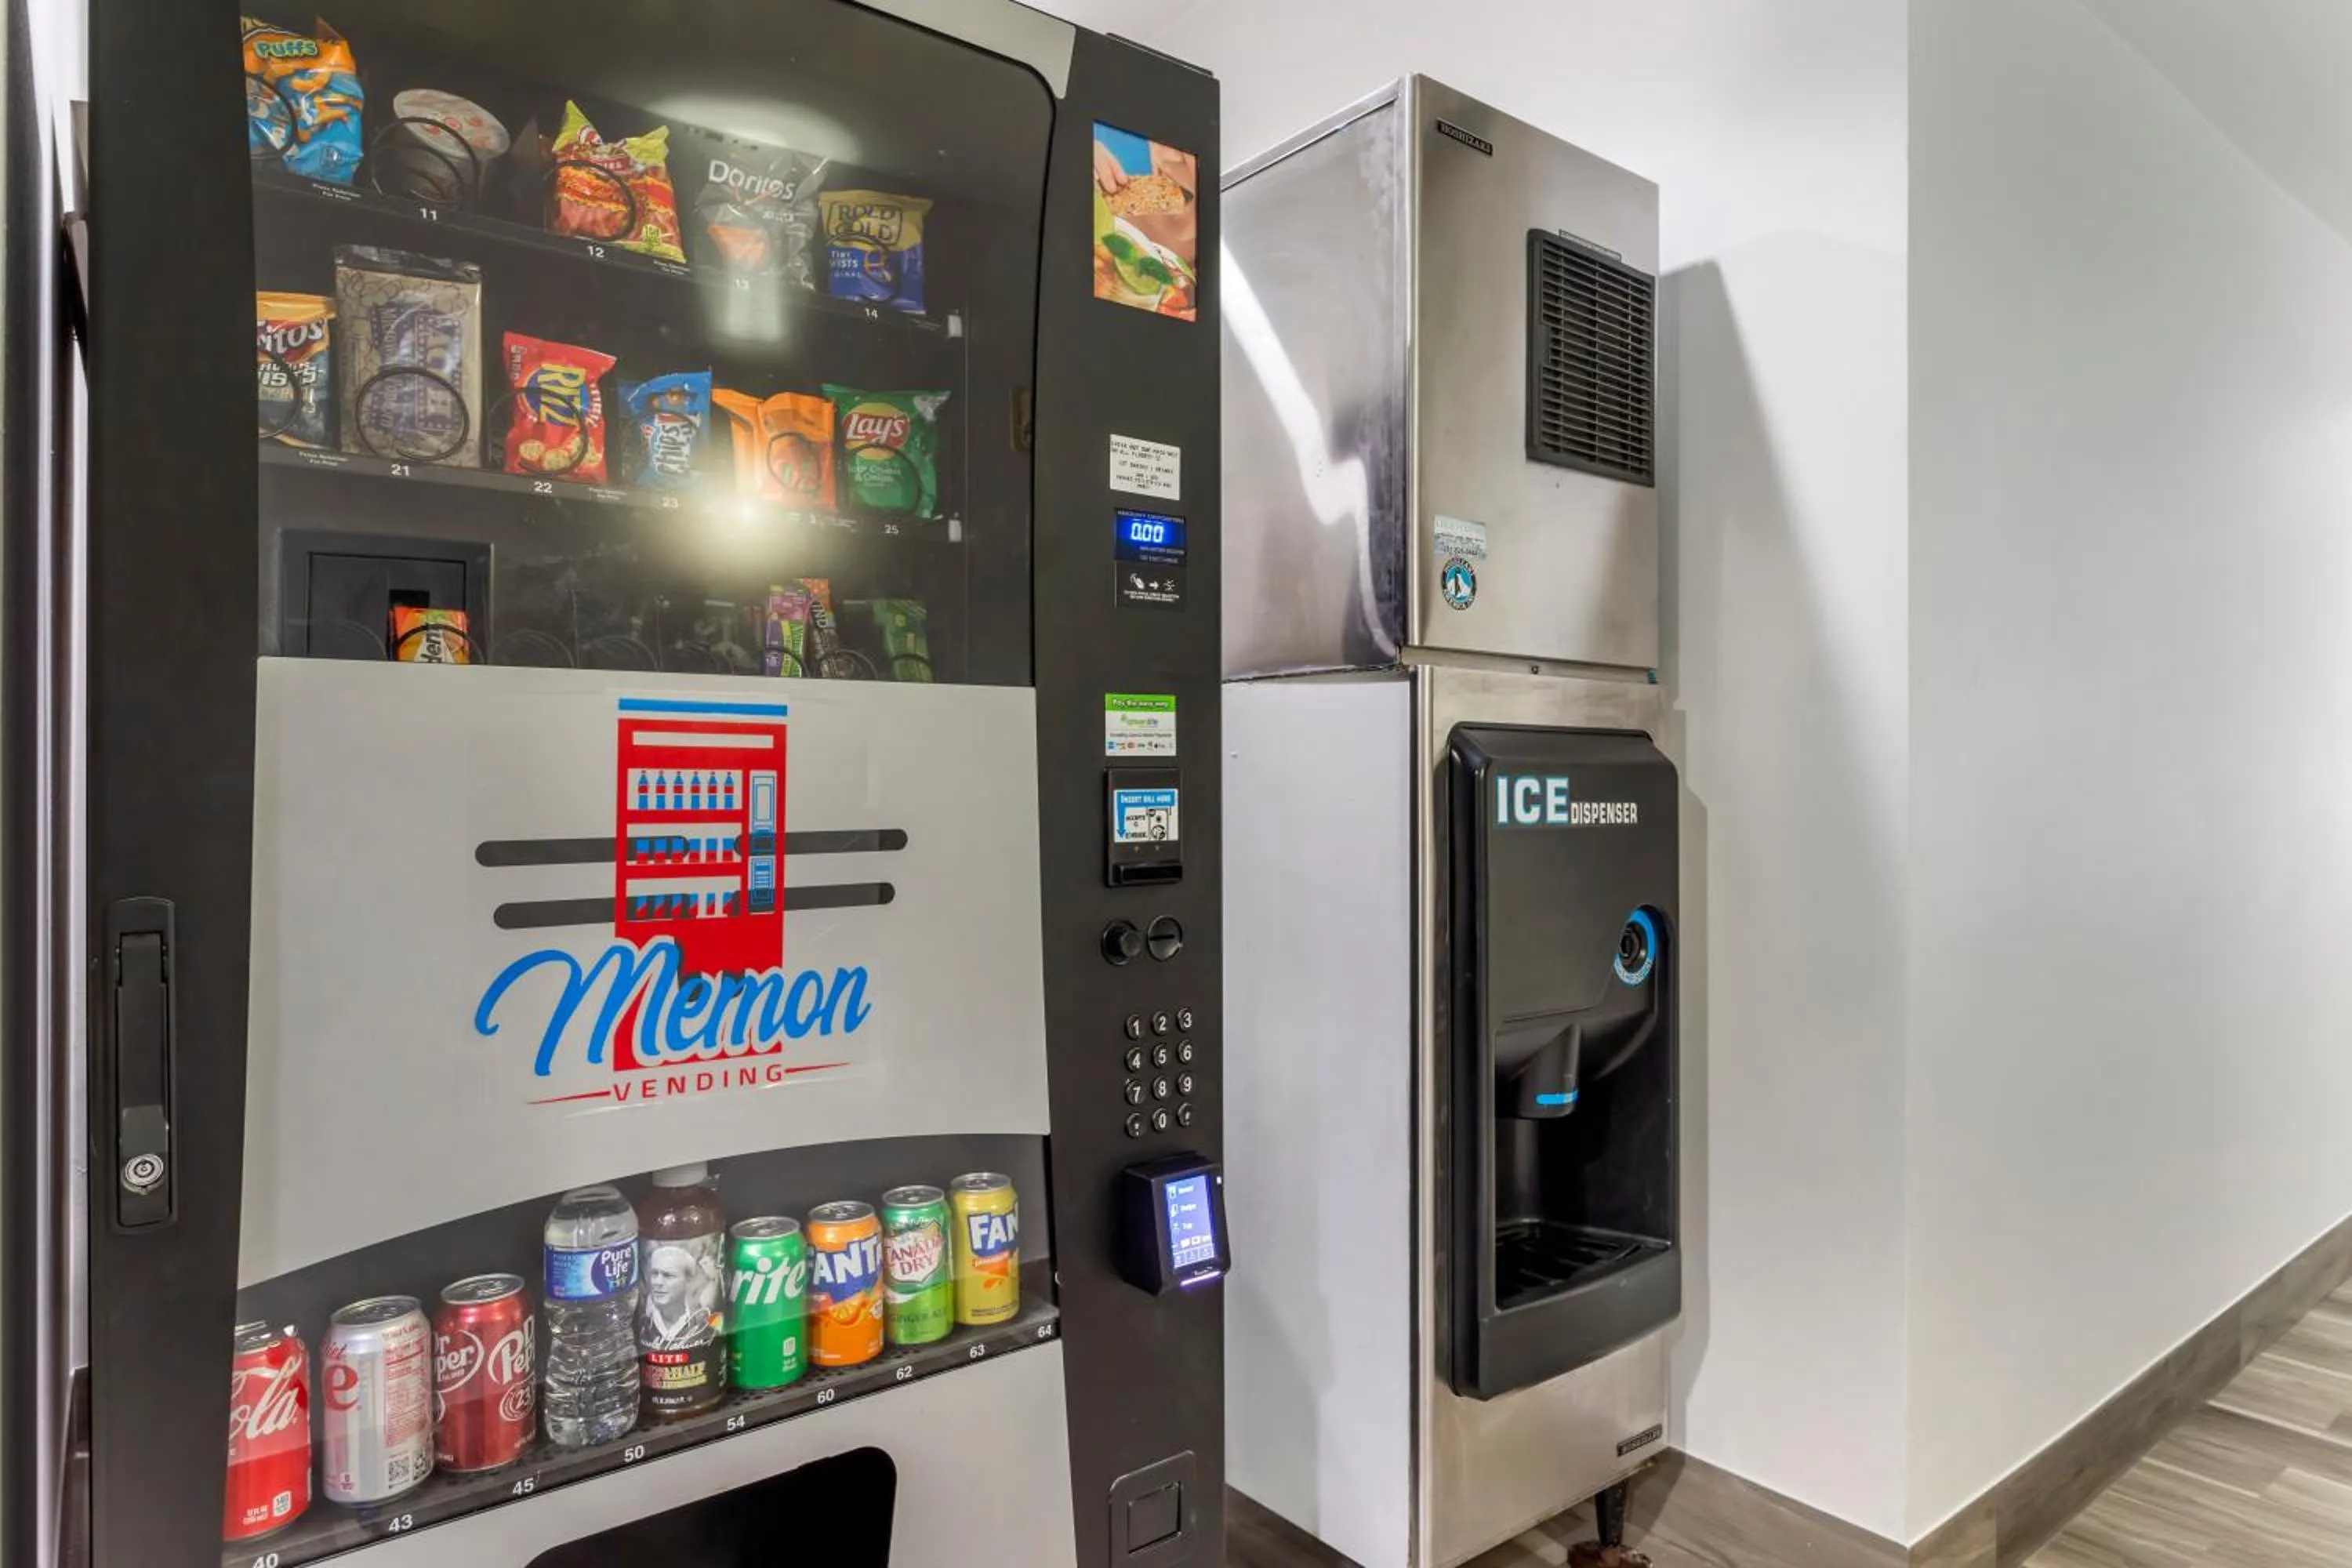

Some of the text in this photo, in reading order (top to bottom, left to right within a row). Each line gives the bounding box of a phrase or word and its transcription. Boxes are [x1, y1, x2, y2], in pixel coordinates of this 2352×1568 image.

[255, 40, 318, 58] Puffs
[709, 159, 795, 201] Doritos
[419, 208, 437, 221] 11
[838, 204, 895, 221] ROLD
[587, 245, 605, 259] 12
[865, 307, 879, 319] 14
[257, 321, 321, 354] ritos
[538, 363, 586, 428] RITZ
[845, 413, 906, 445] Lay's
[391, 463, 410, 477] 21
[534, 480, 553, 494] 22
[662, 497, 679, 510] 23
[884, 524, 899, 535] 25
[1497, 777, 1638, 824] ICE DISPENSER
[475, 941, 872, 1076] Memon
[1133, 1012, 1192, 1036] 1 2 3
[1132, 1044, 1192, 1069] 4 5 6
[612, 1063, 782, 1102] VENDING
[1132, 1076, 1192, 1103] 7 8 9
[1159, 1112, 1167, 1129] 0
[970, 1203, 1018, 1250] FAN
[601, 1245, 632, 1266] Pure
[808, 1234, 883, 1287] ANT
[604, 1261, 630, 1280] Life
[898, 1254, 935, 1276] DRY
[729, 1257, 807, 1305] rite
[927, 1309, 946, 1319] AL
[1037, 1324, 1052, 1338] 64
[652, 1353, 684, 1363] LITE
[970, 1345, 985, 1359] 63
[436, 1345, 475, 1383] per
[896, 1365, 913, 1381] 62
[229, 1354, 303, 1440] ola
[516, 1388, 532, 1410] 23
[817, 1388, 835, 1404] 60
[727, 1414, 746, 1432] 54
[623, 1445, 645, 1463] 50
[512, 1477, 535, 1495] 45
[389, 1514, 413, 1533] 43
[252, 1553, 278, 1568] 40
